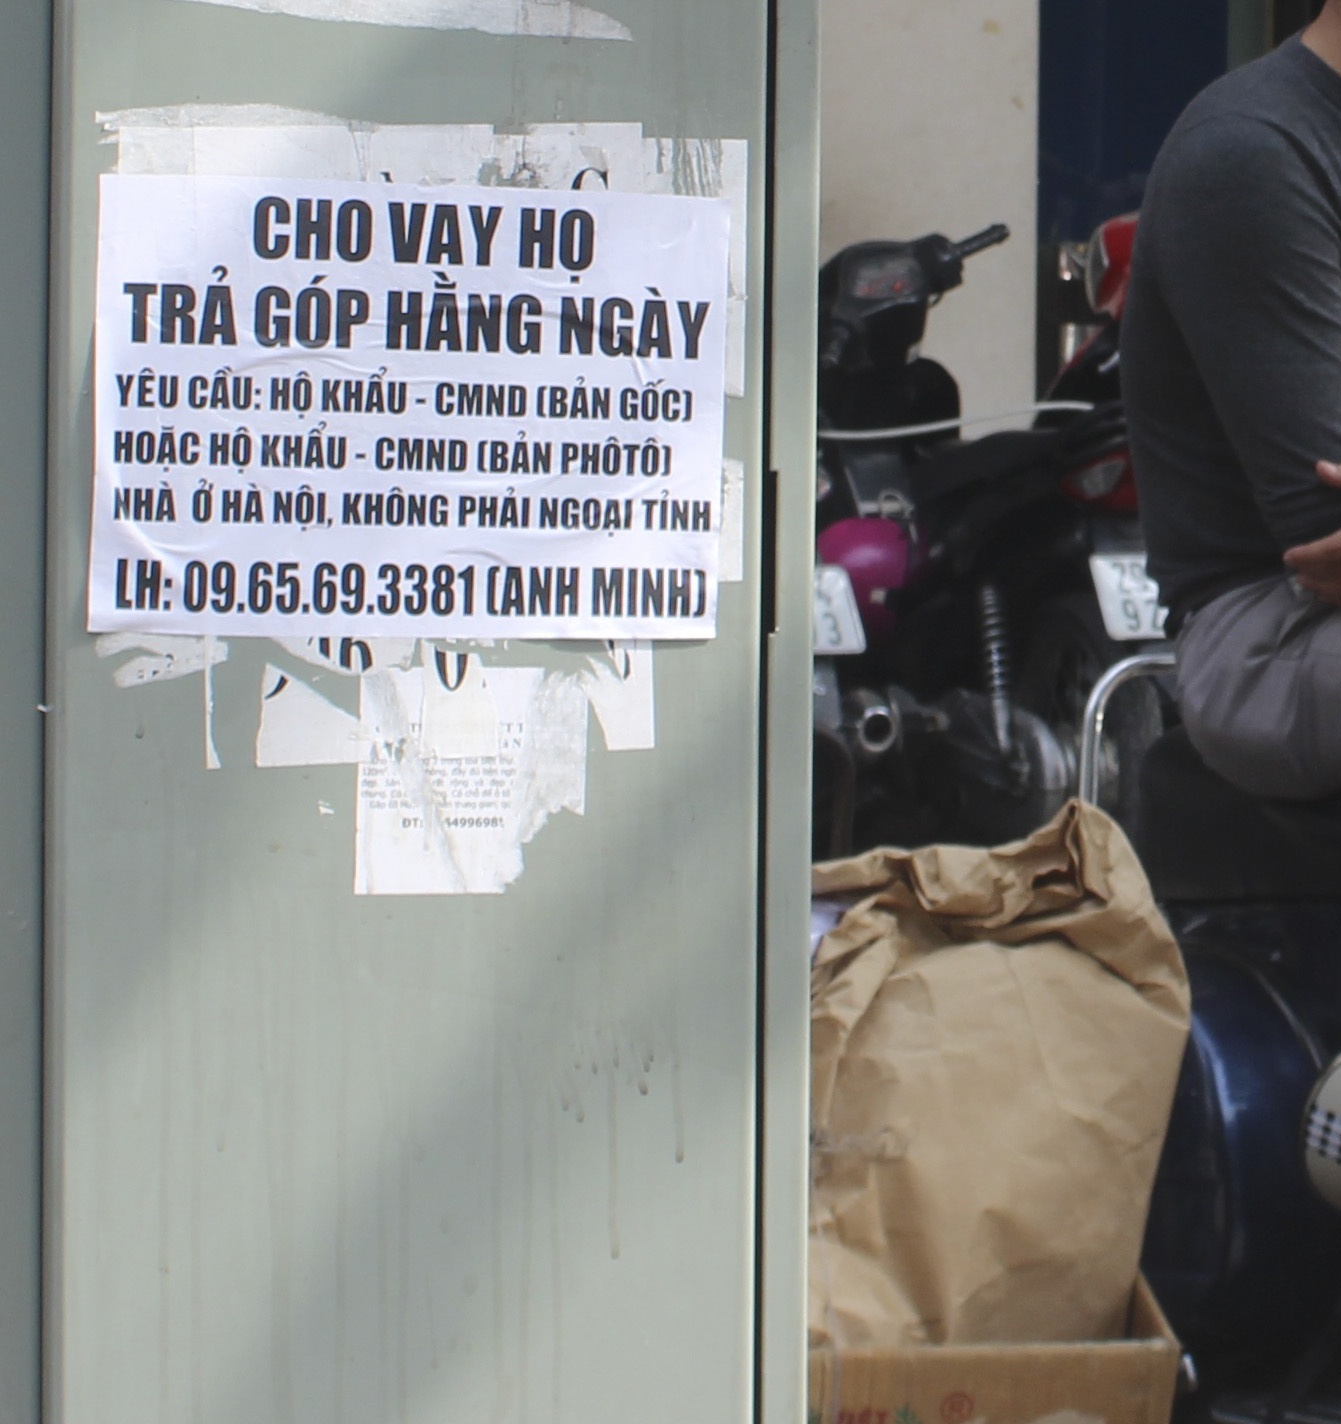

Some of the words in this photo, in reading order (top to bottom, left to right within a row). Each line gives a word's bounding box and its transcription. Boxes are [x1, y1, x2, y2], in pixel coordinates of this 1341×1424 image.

[254, 195, 373, 263] CHO
[388, 202, 503, 267] VAY
[518, 207, 595, 284] HỌ
[123, 265, 238, 346] TRẢ
[254, 275, 370, 349] GÓP
[385, 271, 543, 355] HẰNG
[559, 286, 711, 360] NGÀY
[115, 367, 179, 408] YÊU
[188, 365, 262, 411] CẦU:
[270, 370, 313, 420] HỘ
[321, 365, 408, 414] KHẨU
[435, 380, 527, 418] CMND
[536, 375, 611, 420] (BẢN
[619, 378, 694, 423] GỐC)
[113, 425, 201, 472] HOẶC
[208, 426, 253, 474] HỘ
[260, 420, 347, 470] KHẨU
[375, 436, 469, 473] CMND
[477, 430, 552, 475] (BẢN
[560, 436, 673, 477] PHÔTÔ)
[114, 480, 176, 522] NHÀ
[191, 478, 214, 523] Ở
[221, 482, 264, 523] HÀ
[272, 484, 333, 532] NỘI,
[342, 486, 448, 527] KHÔNG
[457, 486, 531, 530] PHẢI
[539, 496, 633, 538] NGOẠI
[641, 488, 712, 532] TỈNH
[115, 558, 173, 612] LH:
[182, 560, 475, 616] 09.65.69.3381
[486, 565, 580, 618] (ANH
[592, 566, 707, 618] MINH)
